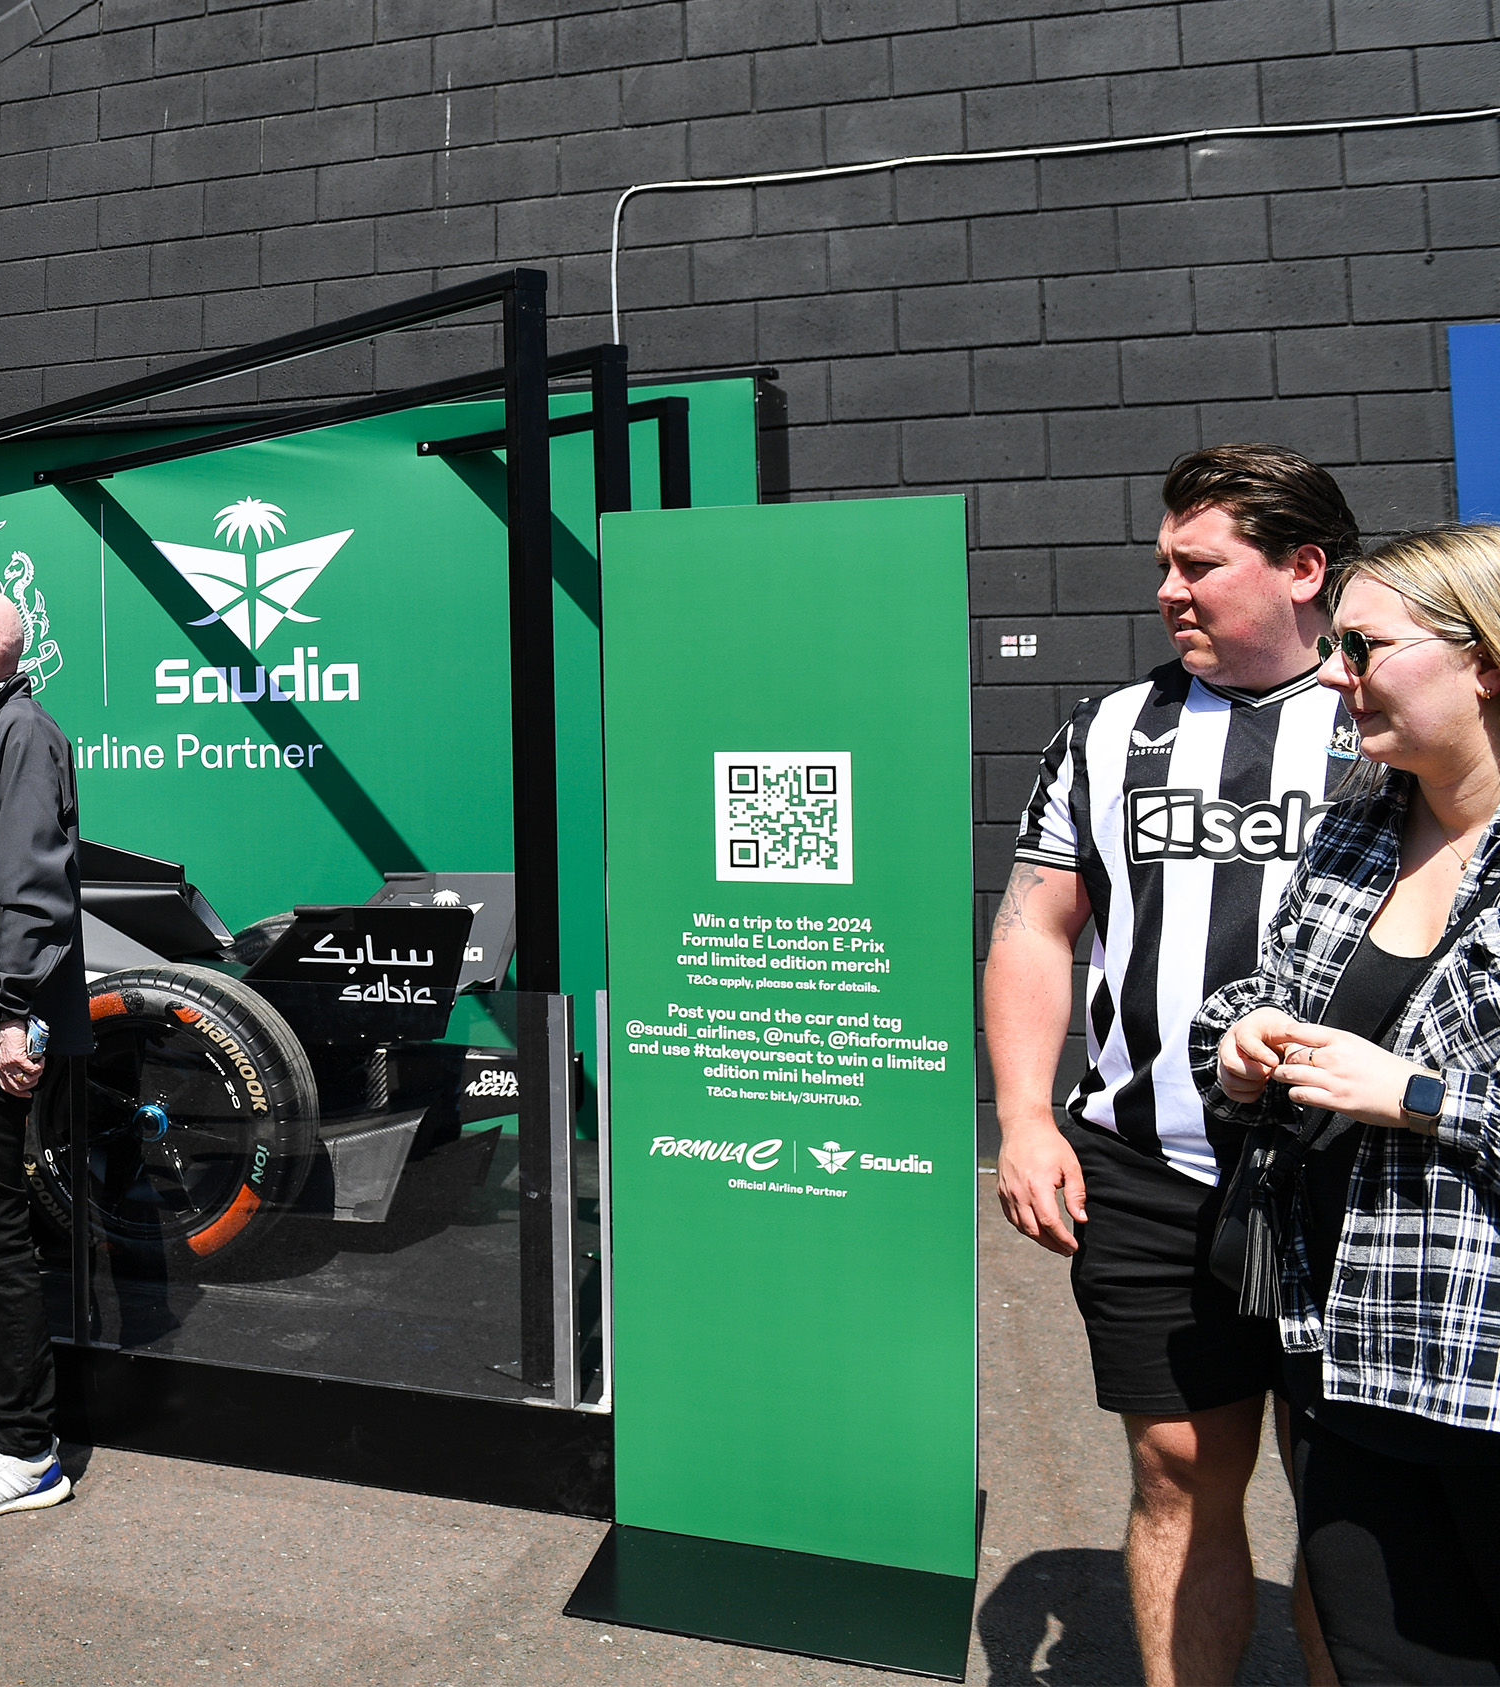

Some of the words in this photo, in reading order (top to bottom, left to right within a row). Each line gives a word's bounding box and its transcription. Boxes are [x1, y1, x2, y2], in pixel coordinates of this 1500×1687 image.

[155, 646, 360, 704] Saudia
[76, 733, 165, 770] irline
[176, 733, 323, 770] Partner
[1128, 747, 1172, 757] CASTORE
[1199, 796, 1328, 855] sel
[692, 912, 726, 928] Win
[728, 917, 740, 929] a
[742, 915, 773, 934] trip
[774, 916, 794, 931] to
[795, 915, 824, 932] the
[826, 916, 873, 933] 2024
[682, 931, 749, 949] Formula
[752, 934, 764, 949] E
[767, 934, 829, 952] London
[832, 936, 885, 954] E-Prix
[676, 951, 708, 966] and
[711, 951, 767, 969] limited
[769, 954, 828, 971] edition
[831, 957, 890, 974] merch!
[338, 973, 438, 1005] sabic
[686, 973, 719, 986] T&Cs
[719, 976, 755, 990] apply,
[755, 977, 794, 990] please
[795, 979, 817, 990] ask
[818, 979, 837, 991] for
[667, 1003, 705, 1020] Post
[706, 1008, 737, 1024] you
[739, 1007, 771, 1023] and
[773, 1008, 802, 1024] the
[804, 1013, 835, 1026] car
[836, 1012, 870, 1028] and
[872, 1014, 902, 1033] tag
[625, 1019, 761, 1044] @saudi_airlines,
[763, 1026, 825, 1048] @nufc,
[827, 1030, 949, 1052] @fiaformulae
[628, 1039, 659, 1055] and
[662, 1044, 691, 1057] use
[692, 1042, 814, 1065] #takeyourseat
[815, 1050, 835, 1066] to
[837, 1052, 869, 1068] win
[871, 1056, 883, 1068] a
[886, 1053, 946, 1072] limited
[703, 1063, 760, 1081] edition
[762, 1067, 798, 1083] mini
[801, 1068, 865, 1087] helmet!
[705, 1085, 739, 1099] T&Cs
[650, 1136, 747, 1163] FORMULA
[860, 1154, 932, 1173] Saudia
[727, 1178, 767, 1191] Official
[767, 1181, 804, 1195] Airline
[805, 1184, 848, 1198] Partner
